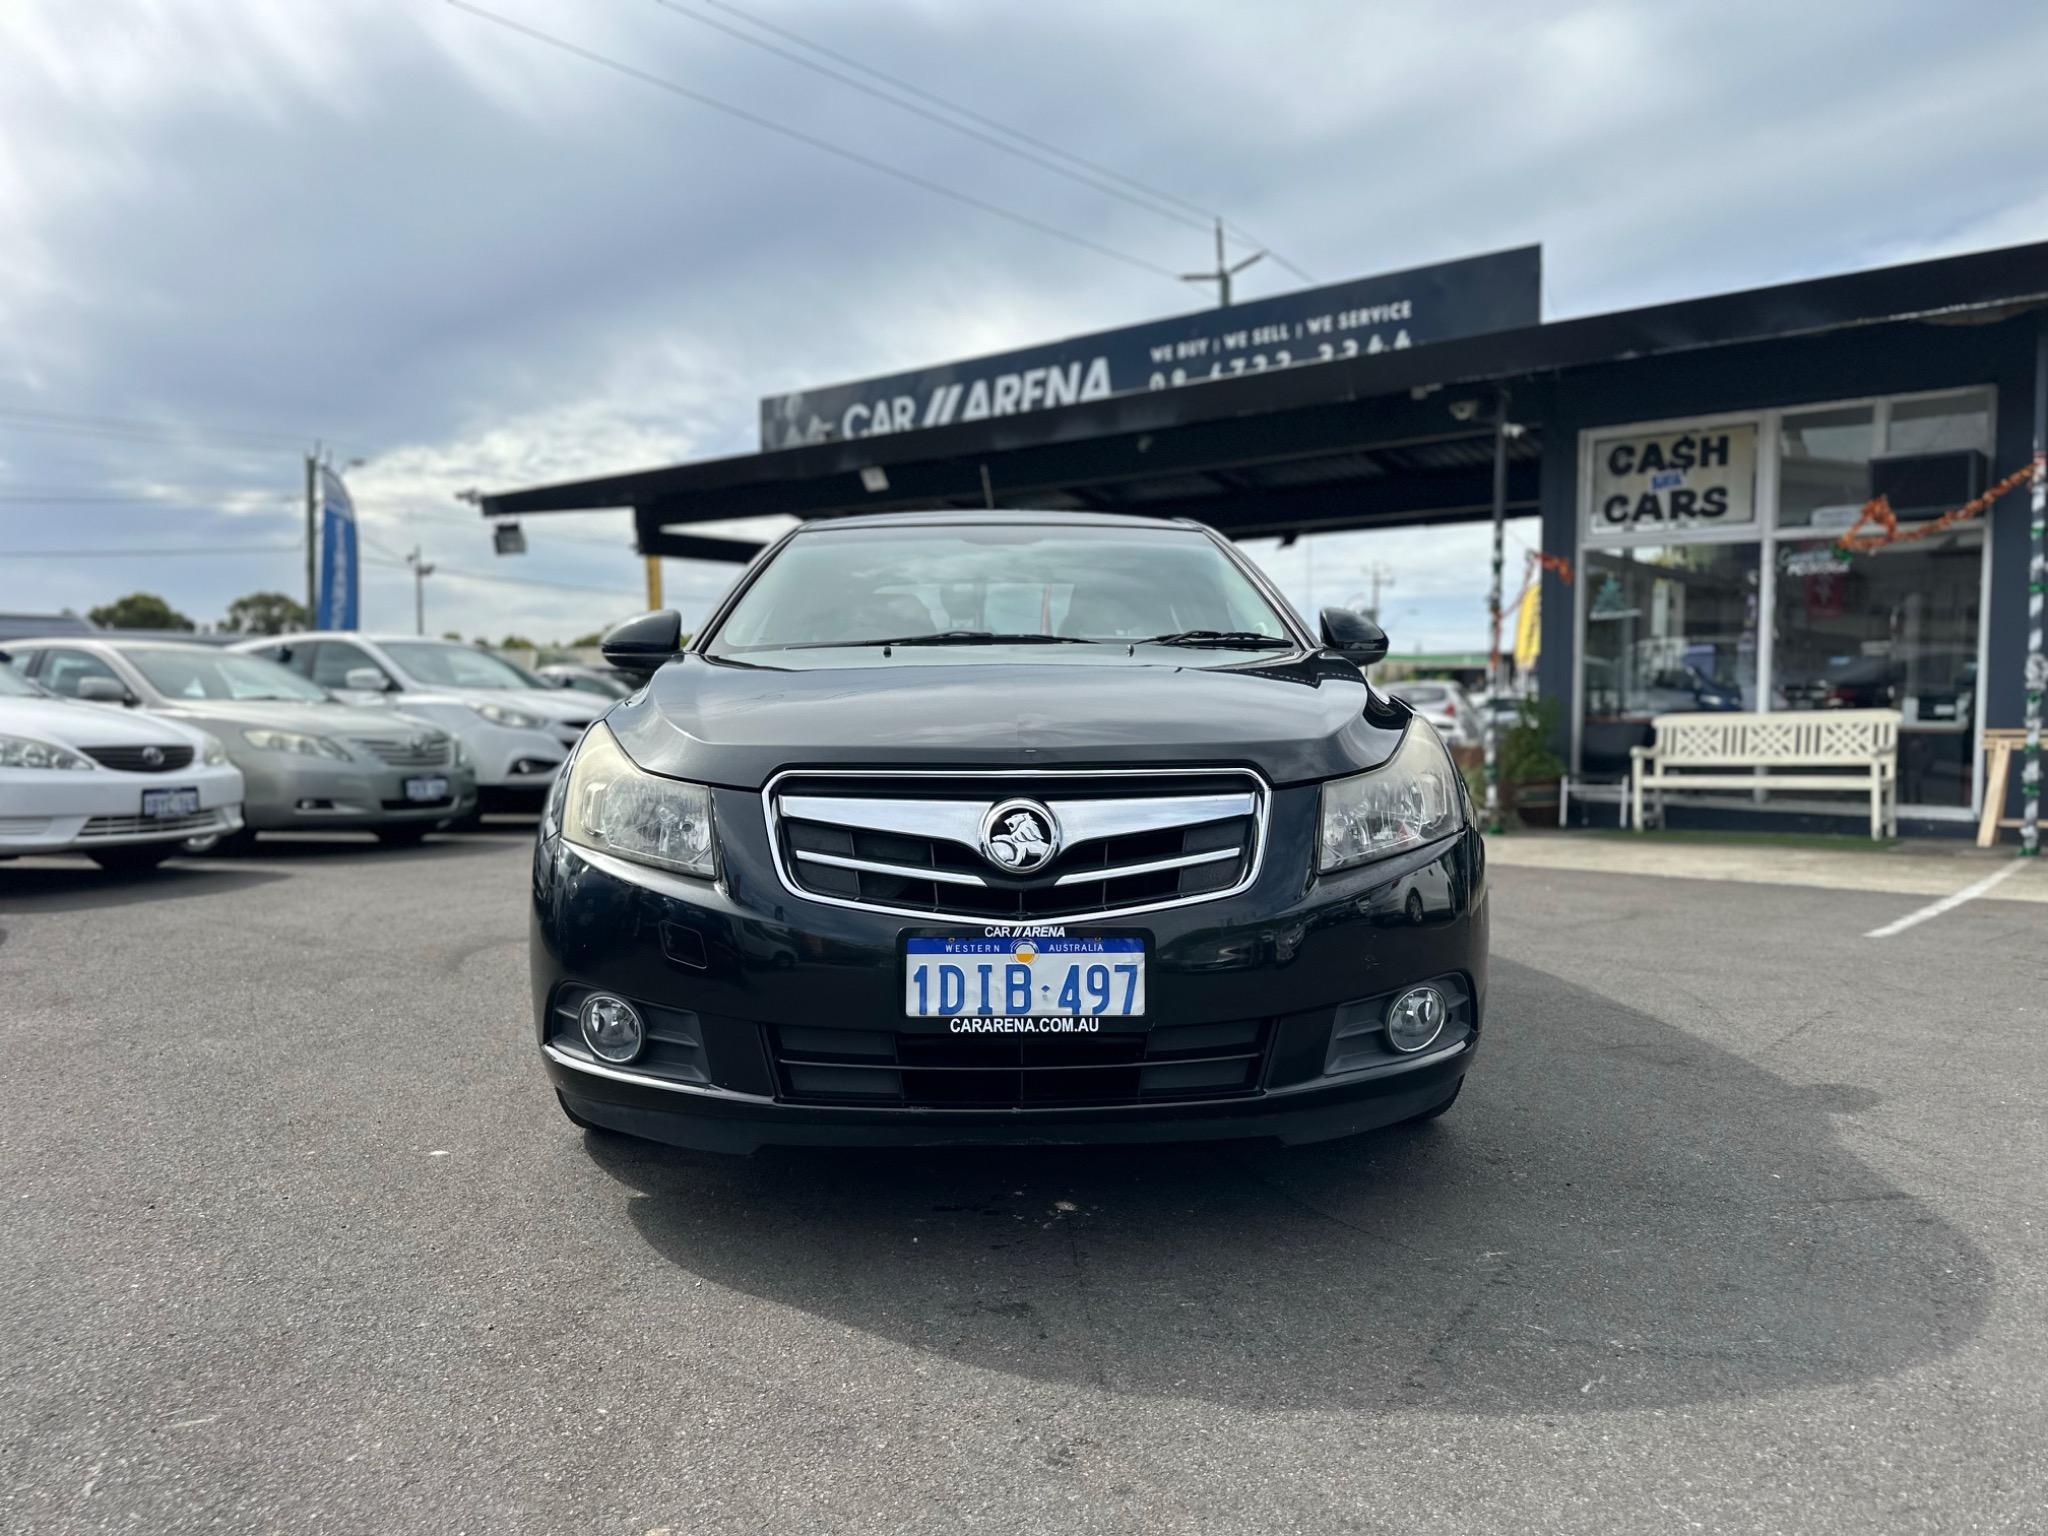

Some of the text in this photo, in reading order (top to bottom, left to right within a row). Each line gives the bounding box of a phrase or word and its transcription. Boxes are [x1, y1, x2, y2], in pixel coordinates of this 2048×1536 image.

[1151, 299, 1412, 363] WE BUY WE SELL WE SERVICE
[841, 395, 917, 440] CAR
[1604, 486, 1728, 523] CARS
[945, 943, 1104, 953] WESTERN AUSTRALIA
[984, 926, 1010, 938] CAR
[913, 963, 1138, 1016] 1DIB 497
[950, 1018, 1100, 1033] CARARENA.COM.AU
